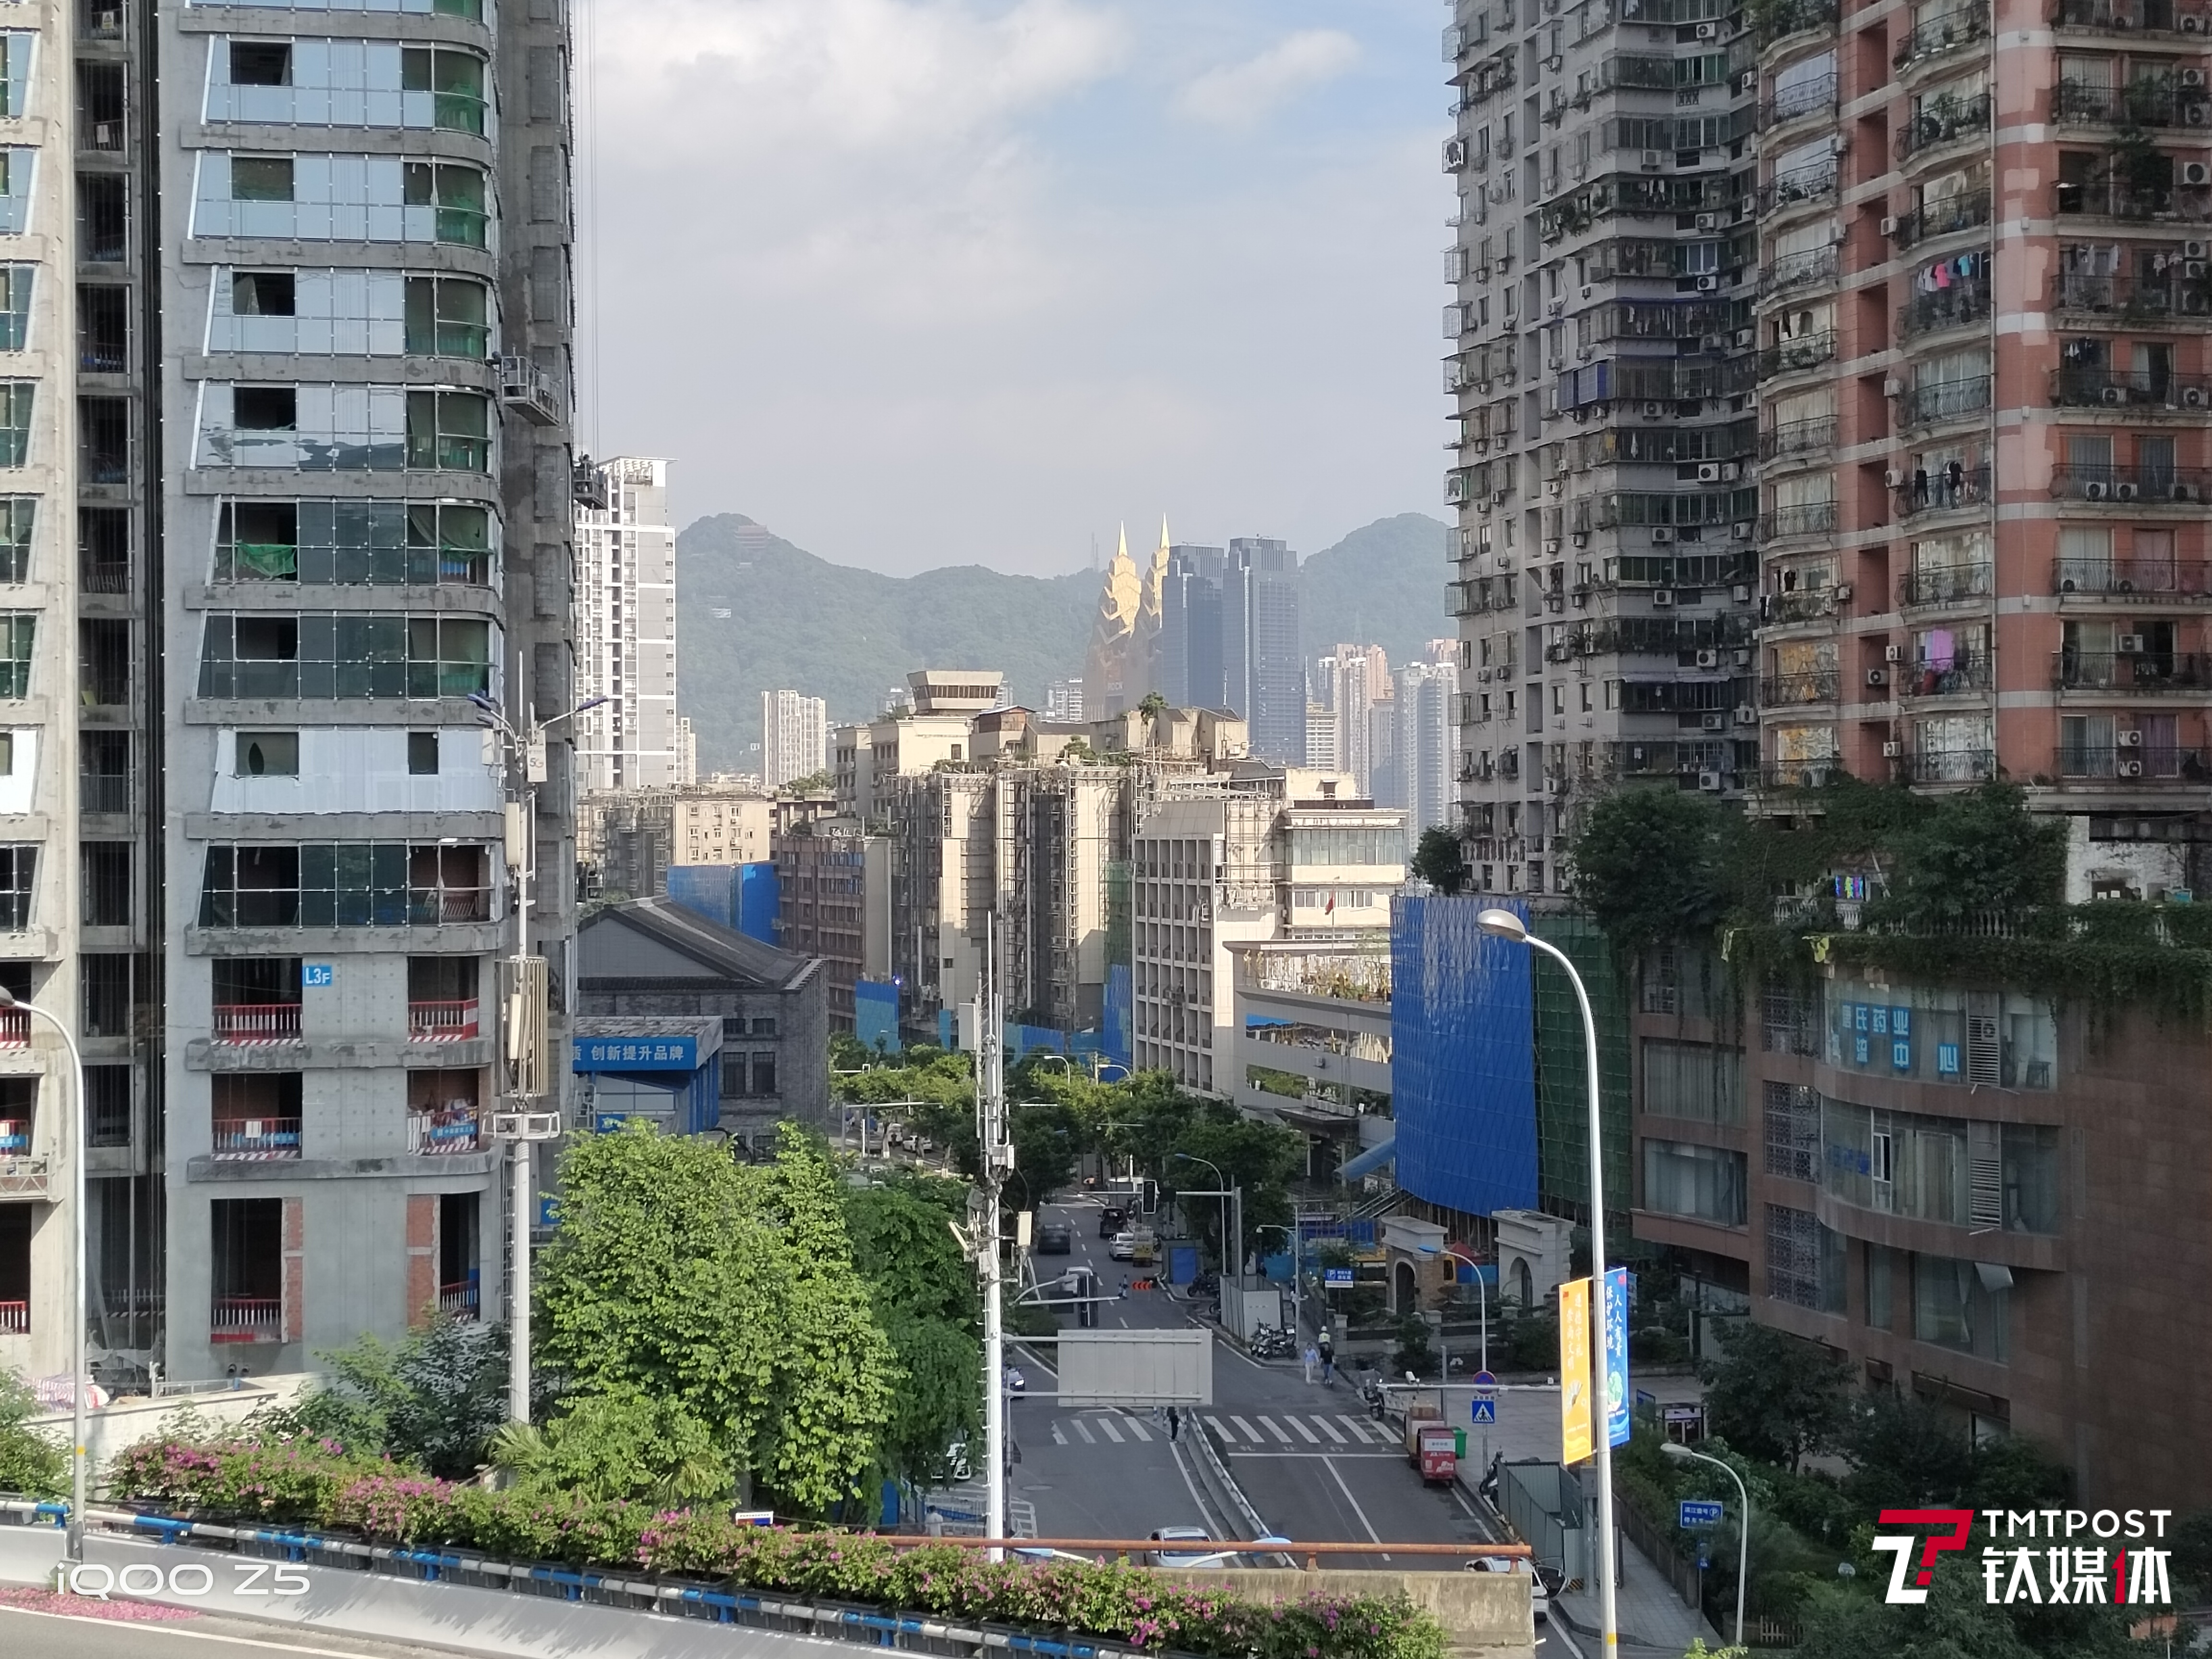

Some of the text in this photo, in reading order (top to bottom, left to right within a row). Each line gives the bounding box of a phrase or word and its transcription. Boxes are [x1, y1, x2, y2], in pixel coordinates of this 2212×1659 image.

[529, 757, 543, 768] 5G
[306, 967, 330, 984] L3F
[591, 1045, 684, 1061] 创新提升品牌
[1614, 1294, 1623, 1358] 人人有责
[1566, 1308, 1575, 1371] 崇尚文明
